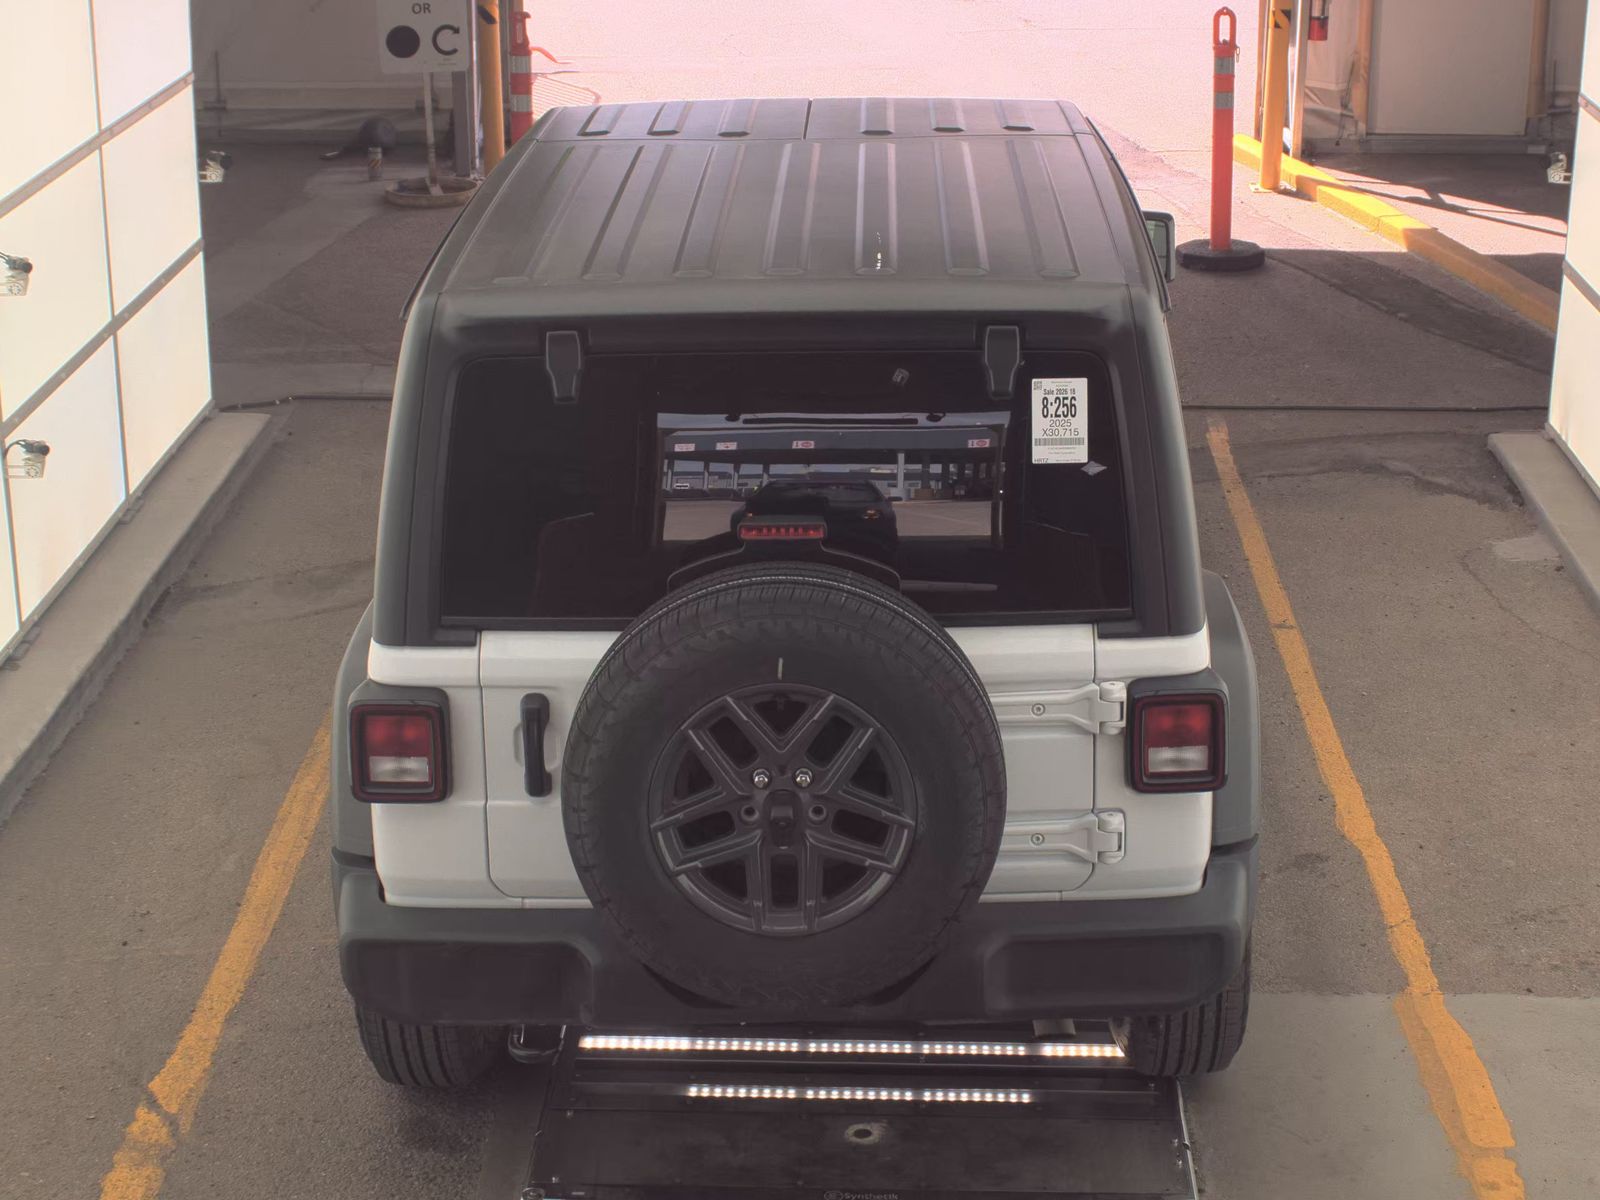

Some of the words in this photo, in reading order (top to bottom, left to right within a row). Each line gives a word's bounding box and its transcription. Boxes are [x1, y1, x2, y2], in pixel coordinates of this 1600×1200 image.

[411, 2, 432, 14] OR
[1043, 388, 1055, 396] Sale
[1041, 396, 1077, 418] 8:256
[1049, 419, 1072, 428] 2025
